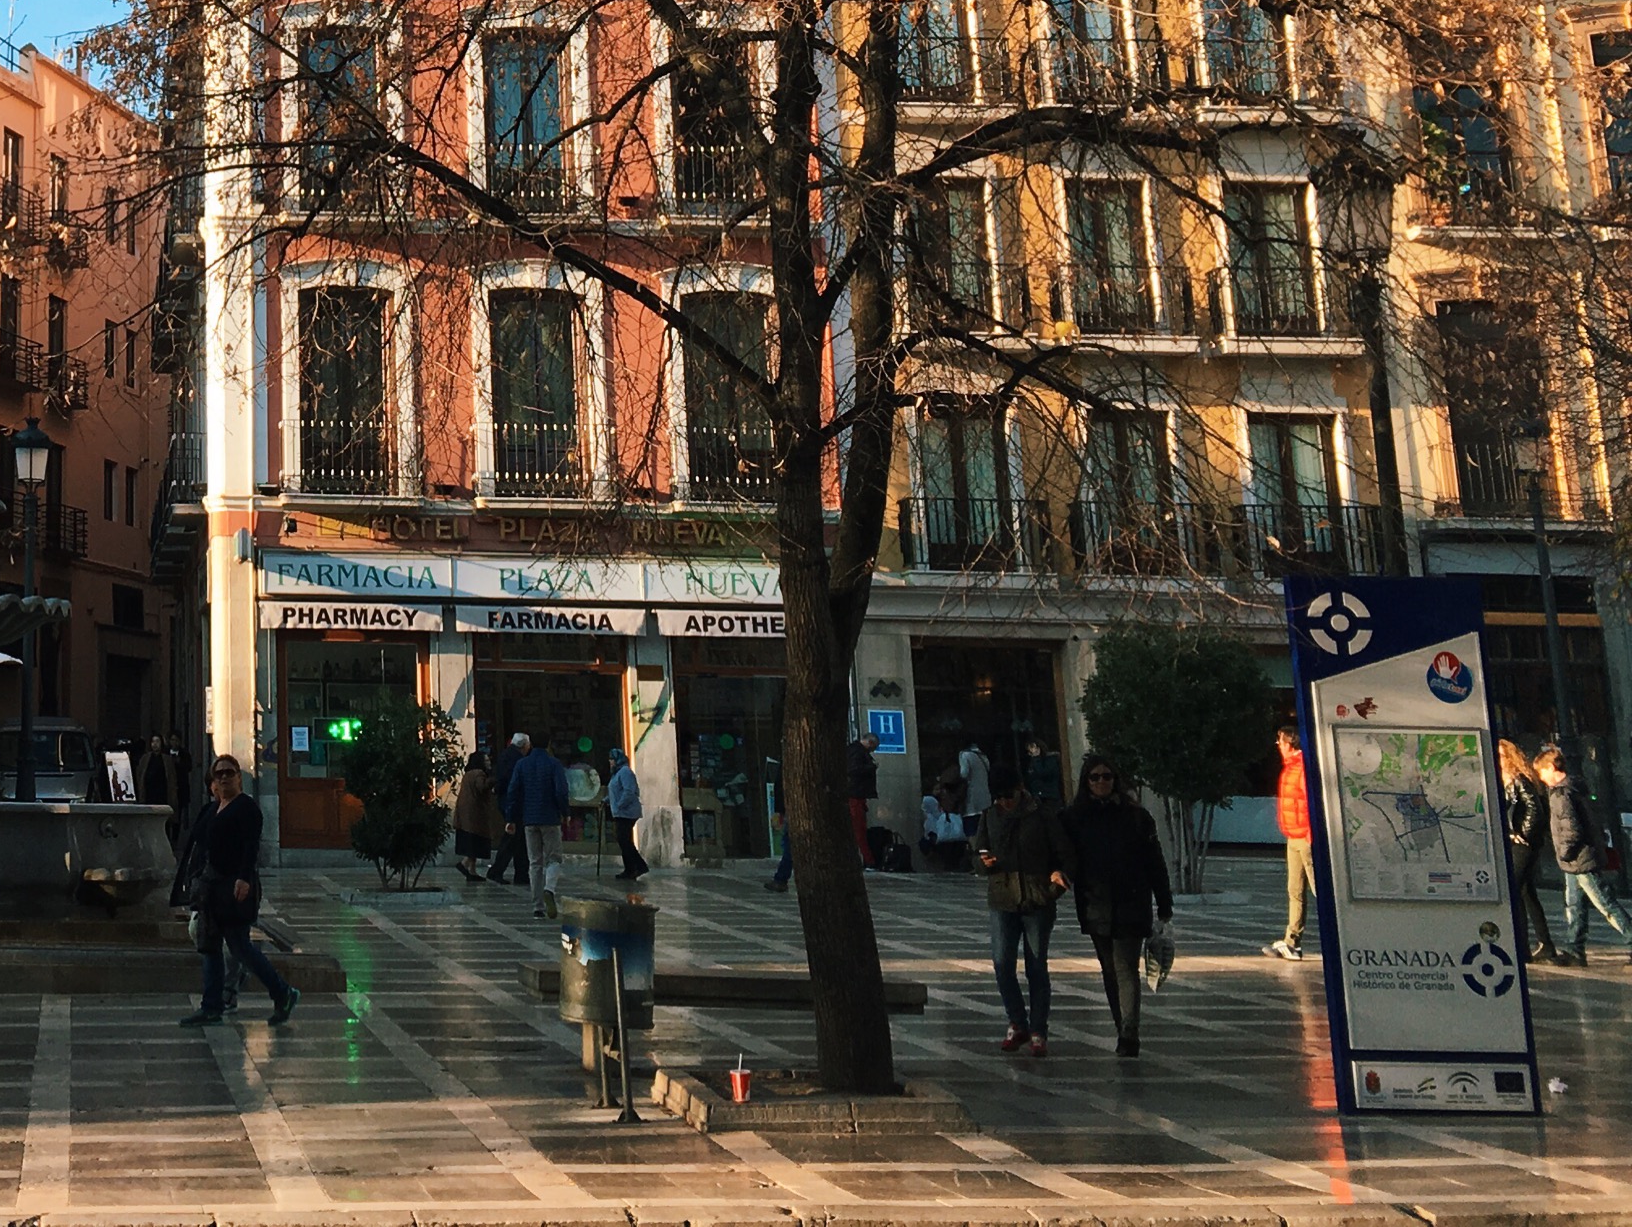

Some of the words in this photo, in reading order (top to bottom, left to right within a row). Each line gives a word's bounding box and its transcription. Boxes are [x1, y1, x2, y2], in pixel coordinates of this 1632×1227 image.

[371, 516, 460, 540] HOTEL
[499, 518, 597, 542] PLAZA
[632, 521, 726, 546] NUEVA
[277, 564, 437, 590] FARMACIA
[499, 568, 596, 593] PLAZA
[282, 607, 418, 627] PHARMACY
[488, 611, 614, 632] FARMACIA
[685, 615, 785, 634] APOTHE
[878, 714, 896, 735] H
[1347, 949, 1456, 968] GRANADA
[1357, 969, 1393, 980] Centro
[1396, 971, 1449, 981] Comercial
[1399, 981, 1411, 990] de
[1413, 981, 1455, 992] Granada
